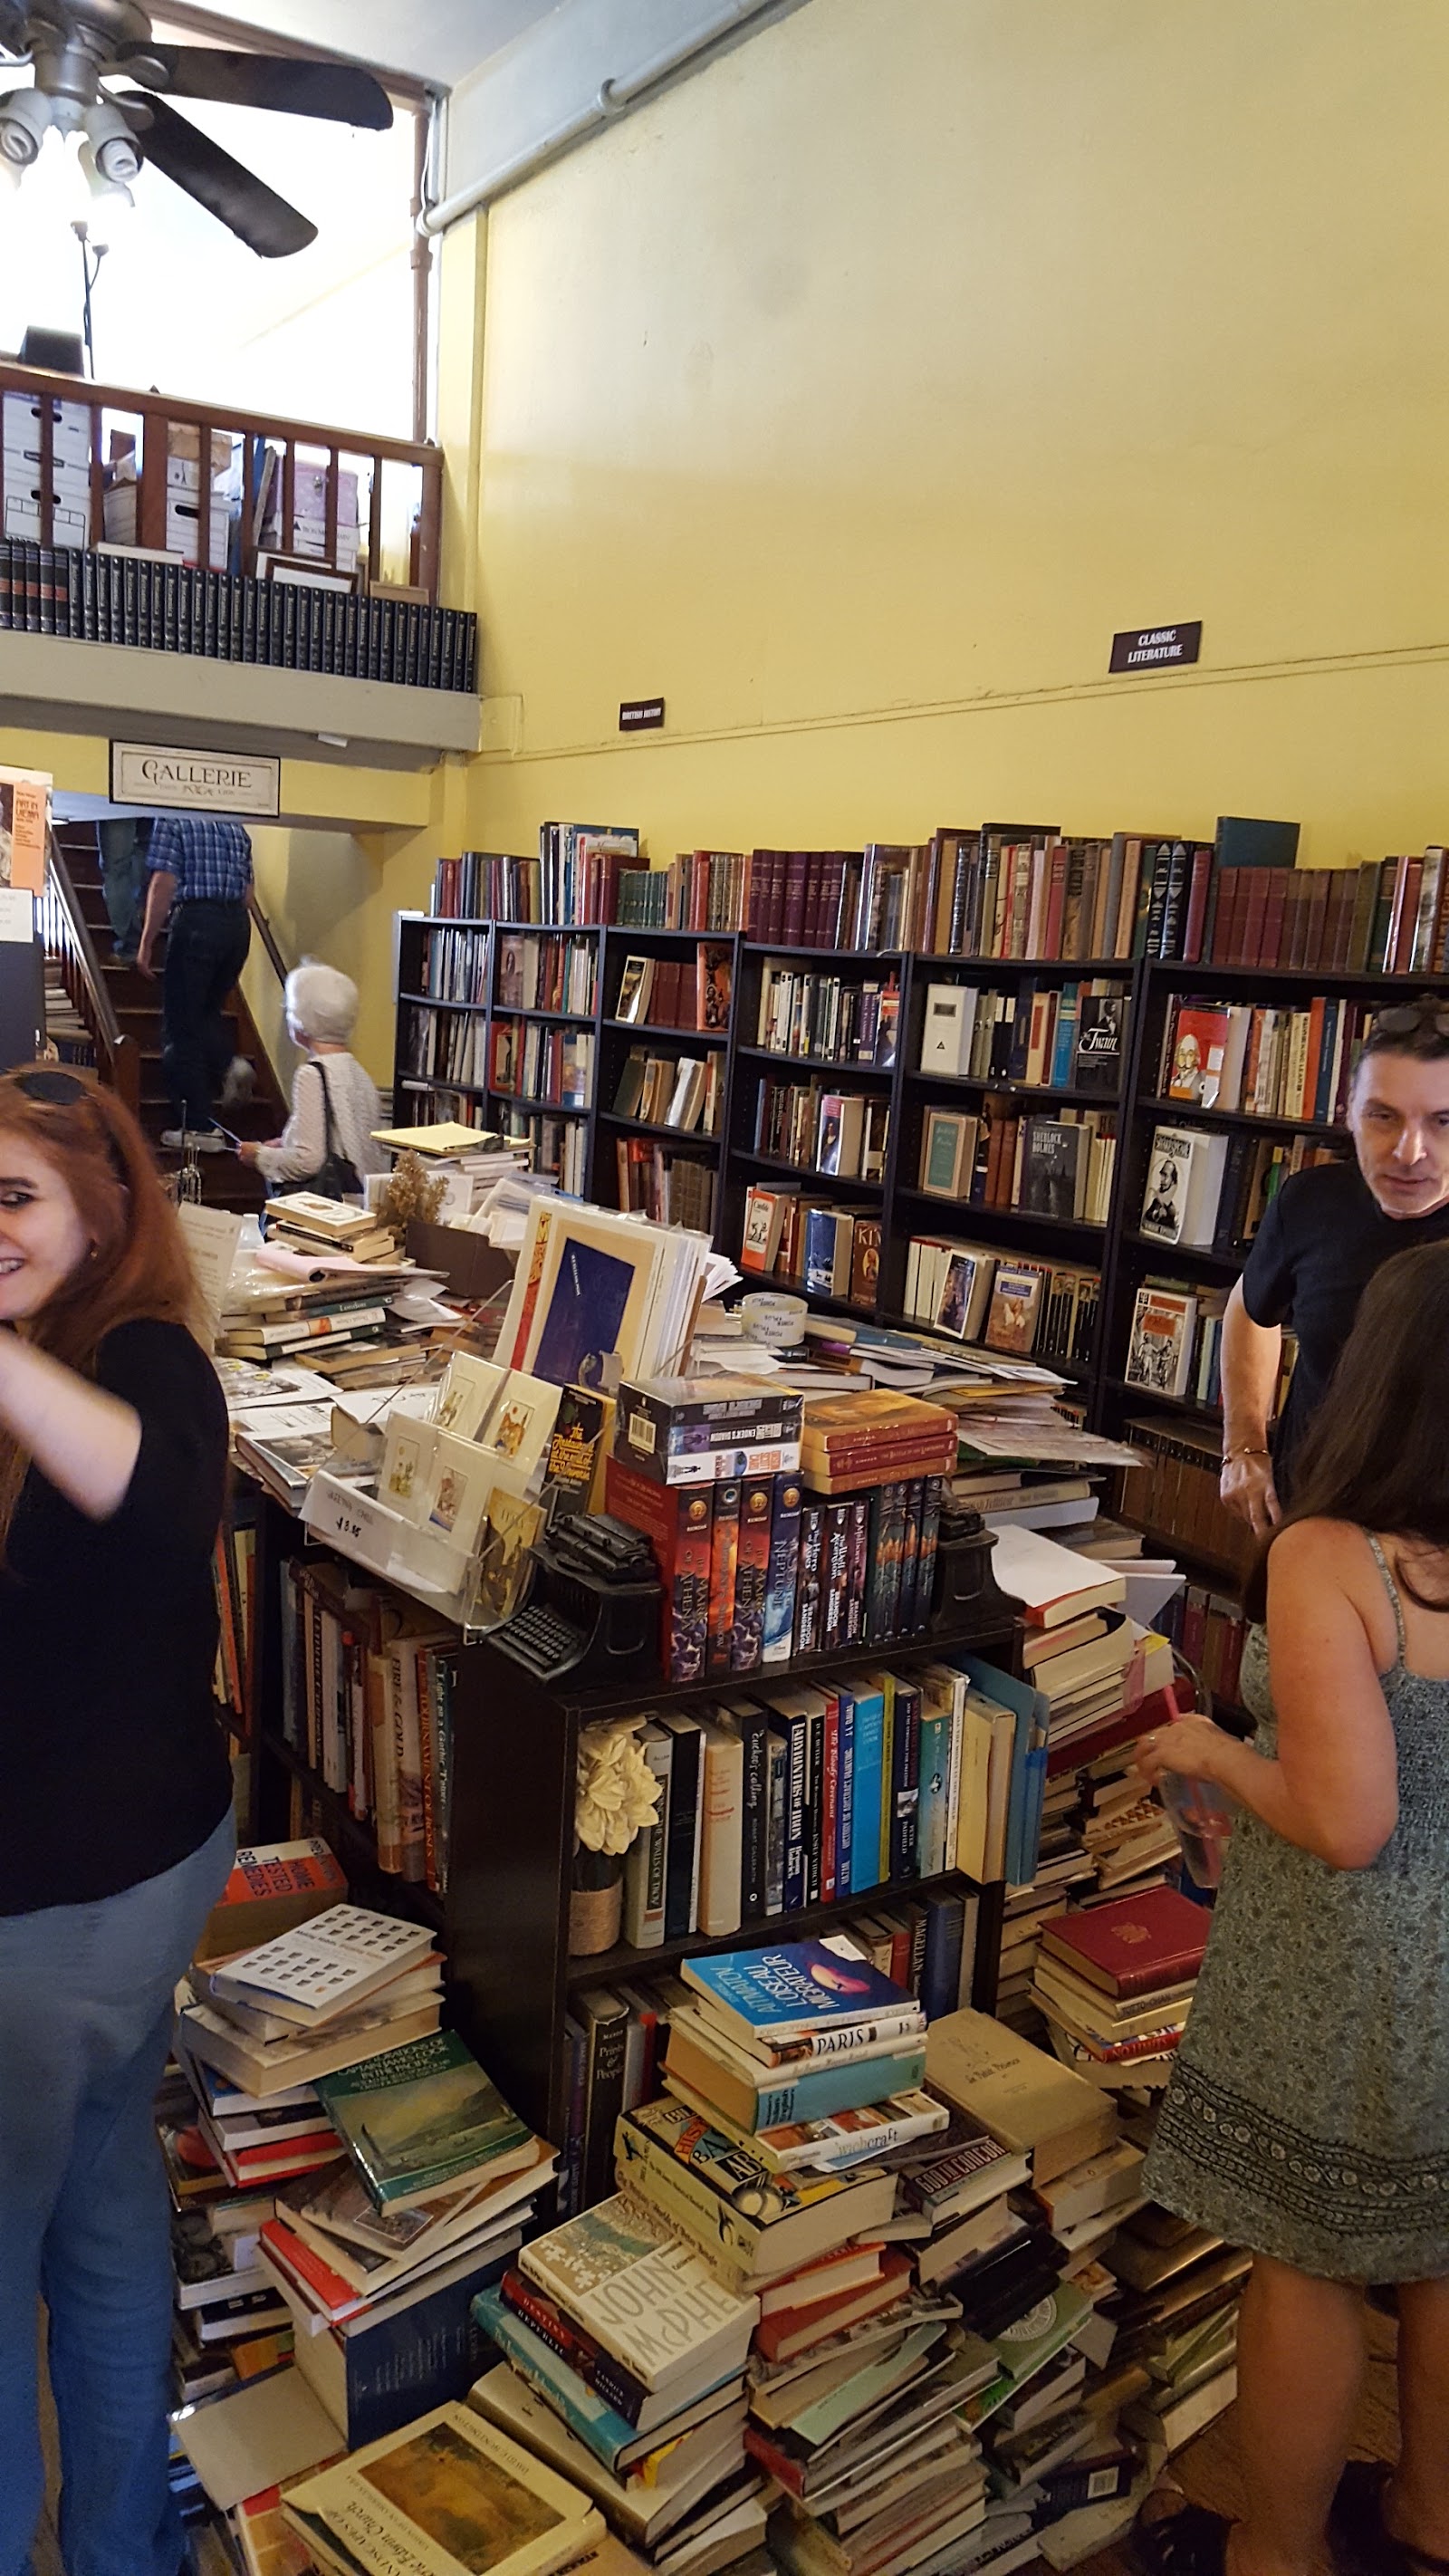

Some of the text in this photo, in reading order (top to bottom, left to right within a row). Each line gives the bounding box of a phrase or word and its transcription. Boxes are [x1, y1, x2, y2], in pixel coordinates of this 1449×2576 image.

[1128, 644, 1183, 663] LITERATURE
[1138, 630, 1176, 647] CLASSIC
[142, 759, 252, 788] GALLERIE
[1032, 1130, 1061, 1144] SHERLOCK
[1032, 1141, 1054, 1154] HOLMES
[805, 1542, 813, 1570] Ages
[811, 1540, 821, 1572] Hero
[830, 1533, 840, 1581] Ascension
[739, 1561, 754, 1620] ATHENA
[753, 1569, 765, 1614] MARK
[772, 1540, 787, 1610] NEPTUNE
[680, 1569, 694, 1630] ATHENA
[695, 1576, 708, 1623] MARK
[827, 1589, 835, 1631] SANDERSON
[832, 1591, 840, 1627] BRANDON
[851, 1600, 859, 1634] BRANDON
[800, 1602, 808, 1650] SANDERSON
[805, 1606, 813, 1645] BRANDON
[392, 1658, 405, 1758] FIRE & GOLD
[438, 1729, 447, 1766] Gothic
[792, 1722, 806, 1797] LABYRINTHS
[826, 1743, 839, 1775] Bloody
[843, 1747, 853, 1779] PAINTING
[749, 1770, 763, 1810] calling
[828, 1775, 839, 1819] Covenant
[842, 1780, 853, 1812] ABSTRACT
[791, 1808, 801, 1841] IRON
[841, 1821, 851, 1850] HISTORY
[654, 1837, 664, 1869] WALLS
[237, 1850, 272, 1897] REMEDIES
[263, 1856, 293, 1892] TESTED
[290, 1861, 315, 1890] HOME
[653, 1869, 662, 1881] OF
[650, 1881, 661, 1906] TROY
[914, 1918, 926, 1970] MAGELLAN
[710, 1966, 782, 2014] AITMATOV
[762, 1954, 841, 2009] MIGRATEUR
[415, 2045, 449, 2060] COOK
[599, 2043, 625, 2058] Prints
[816, 2028, 864, 2055] PARIS
[596, 2066, 625, 2081] People
[606, 2056, 619, 2068] &
[915, 2170, 943, 2194] GOD
[590, 2256, 686, 2326] JOHN
[517, 2309, 565, 2355] REPUBLIC
[345, 2499, 383, 2536] Church
